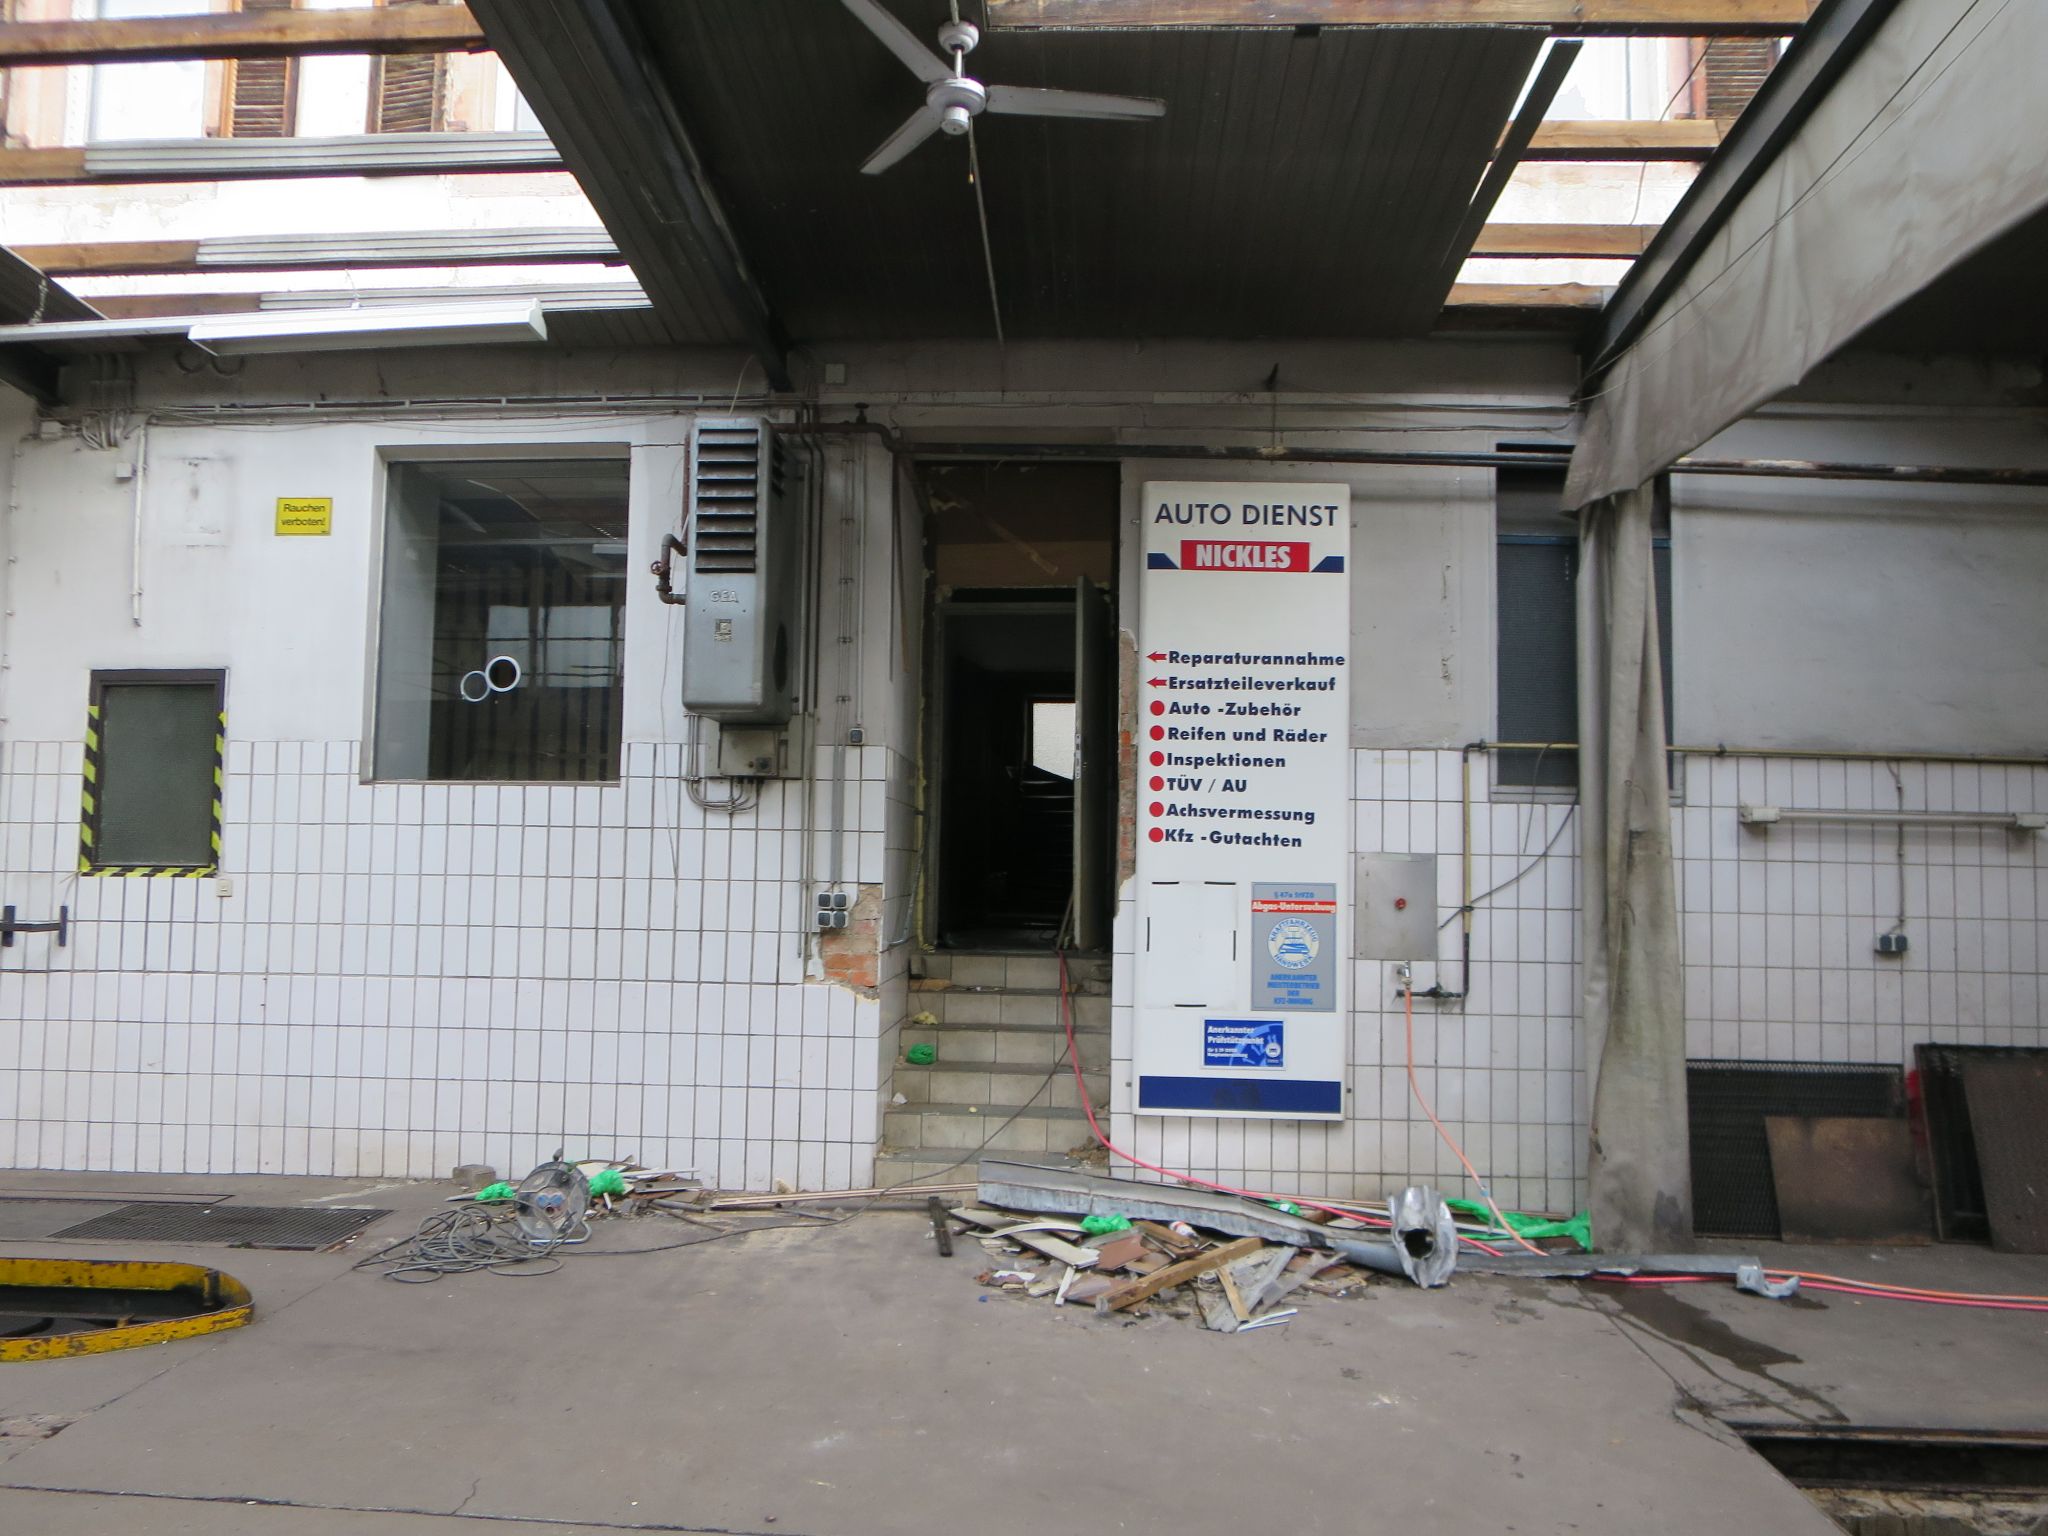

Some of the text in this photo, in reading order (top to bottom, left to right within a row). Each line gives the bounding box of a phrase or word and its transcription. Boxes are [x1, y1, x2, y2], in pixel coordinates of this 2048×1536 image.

[283, 503, 326, 512] Rauchen
[1154, 503, 1338, 527] AUTO DIENST
[281, 518, 326, 526] verboten!
[1196, 544, 1291, 569] NICKLES
[1169, 650, 1345, 667] Reparaturannahme
[1169, 676, 1336, 691] Ersatzteileverkauf
[1169, 702, 1211, 715] Auto
[1168, 726, 1328, 742] Reifen und Räder
[1167, 753, 1286, 769] Inspektionen
[1167, 774, 1203, 792] TÜV
[1222, 779, 1247, 793] AU
[1166, 803, 1315, 825] Achsvermessung
[1165, 828, 1194, 843] Kfz
[1252, 901, 1336, 913] Abgas-Untersuchung
[1270, 918, 1318, 942] KRAFTFAHRZEUG
[1207, 1025, 1255, 1034] Anerkannter
[1207, 1035, 1264, 1045] Prüfstützpunkt
